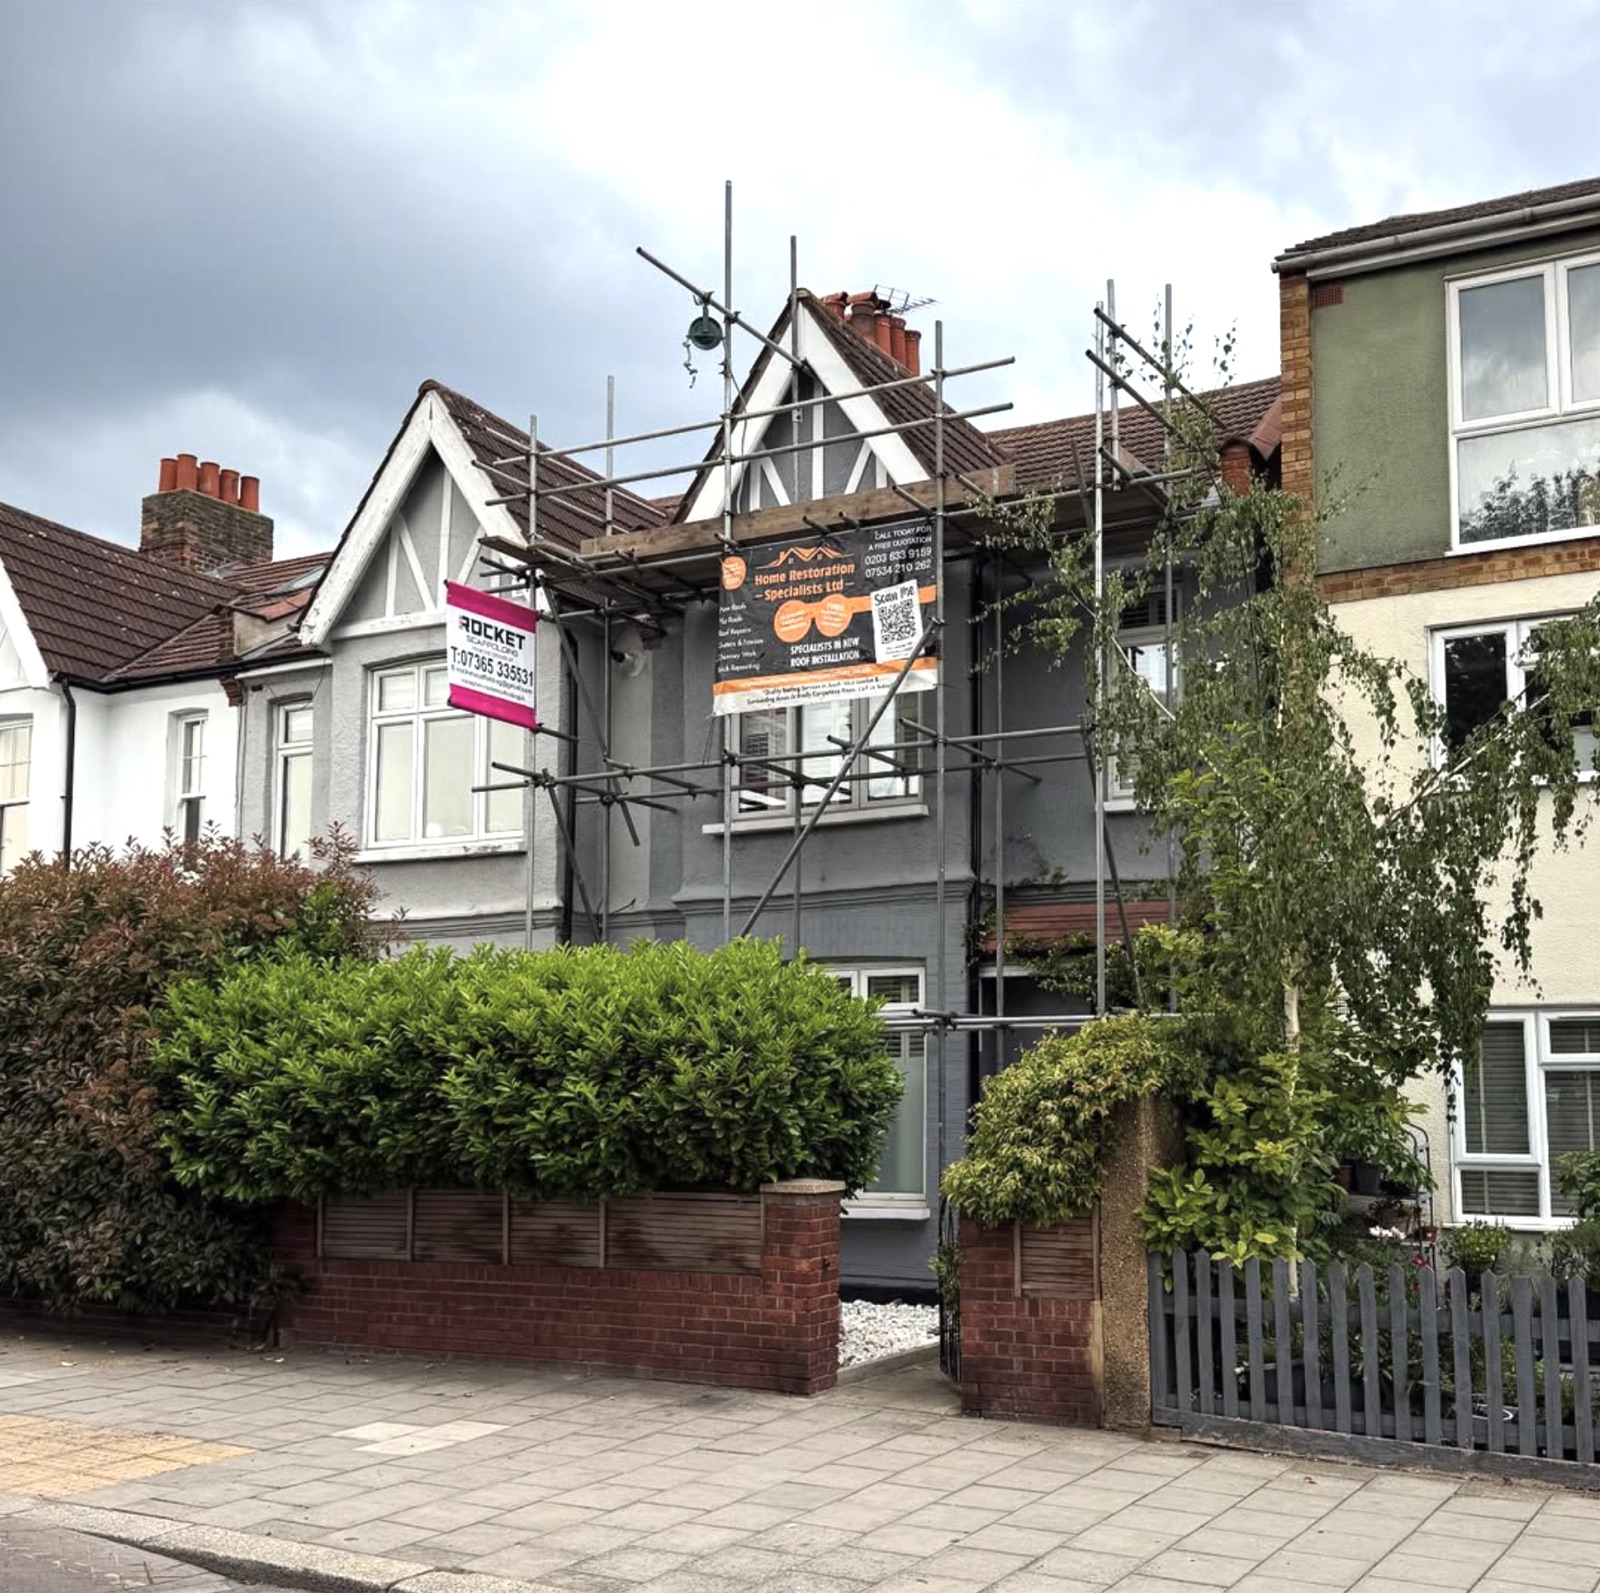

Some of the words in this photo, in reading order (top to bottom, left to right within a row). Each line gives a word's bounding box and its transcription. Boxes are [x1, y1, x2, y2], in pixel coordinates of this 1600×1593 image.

[874, 530, 891, 540] CALL
[893, 527, 916, 537] TODAY
[916, 525, 932, 533] FOR
[874, 541, 891, 550] FREE
[892, 535, 932, 547] QUOTATION
[864, 552, 887, 565] 0203
[889, 549, 906, 561] 633
[755, 572, 786, 586] Home
[789, 563, 855, 581] Restoration
[865, 565, 892, 578] 07534
[894, 562, 913, 574] 210
[914, 559, 932, 571] 262
[764, 581, 823, 602] Specialists
[825, 576, 844, 592] Ltd
[874, 591, 898, 606] Scan
[458, 614, 526, 650] ROCKET
[790, 640, 832, 655] SPECIALISTS
[833, 640, 842, 649] IN
[843, 637, 860, 648] NEW
[450, 645, 494, 674] T:07365
[496, 660, 533, 687] 335531
[790, 656, 810, 667] ROOF
[811, 650, 860, 665] INSTALLATION
